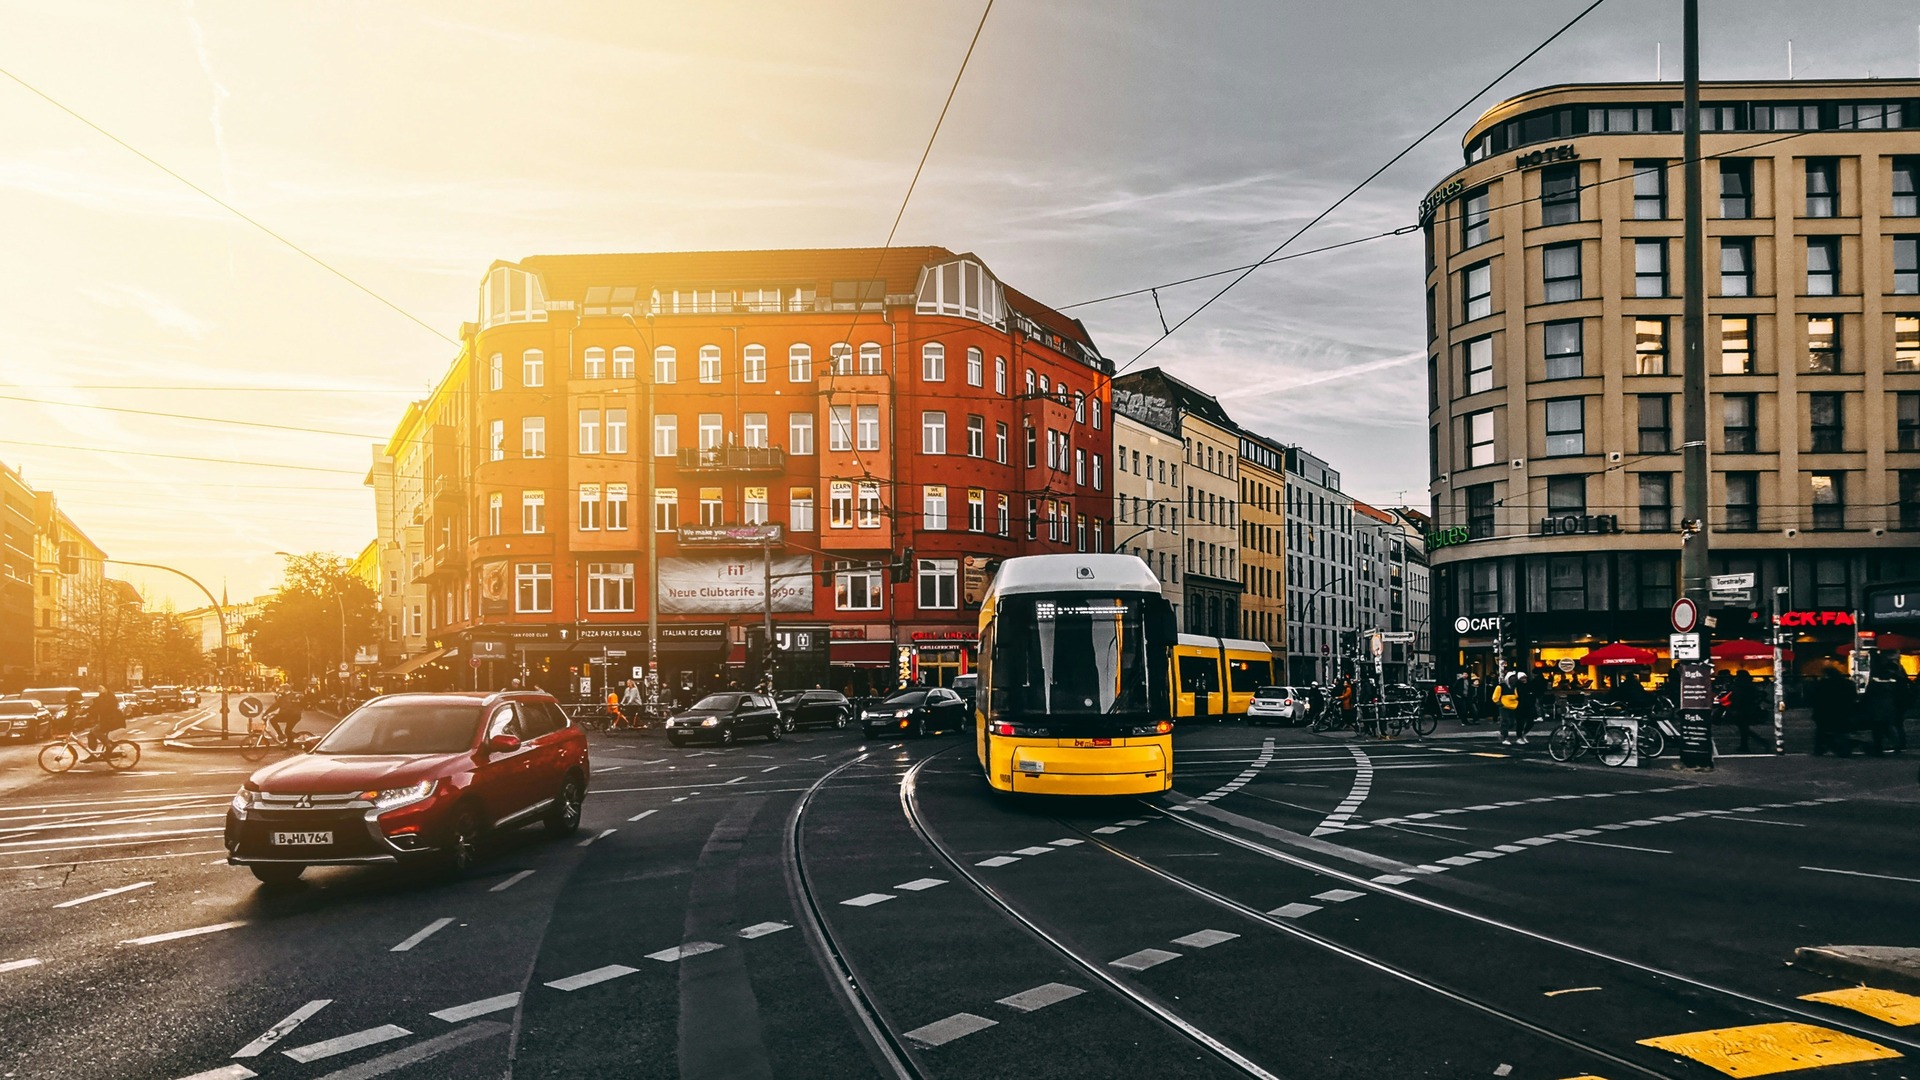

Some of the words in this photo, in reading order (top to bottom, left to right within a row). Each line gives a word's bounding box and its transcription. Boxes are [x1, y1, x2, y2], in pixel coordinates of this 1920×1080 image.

[1517, 144, 1580, 169] HOTEL
[969, 491, 981, 499] YOU
[1541, 515, 1624, 535] HOTEL
[669, 588, 697, 598] Neue
[699, 587, 755, 597] Clubtarife
[798, 587, 804, 595] €
[1894, 594, 1905, 608] U
[912, 631, 937, 640] GRILL
[944, 631, 963, 639] UND
[485, 642, 493, 651] U
[279, 833, 286, 844] B
[292, 833, 307, 844] HA
[308, 832, 328, 844] 764
